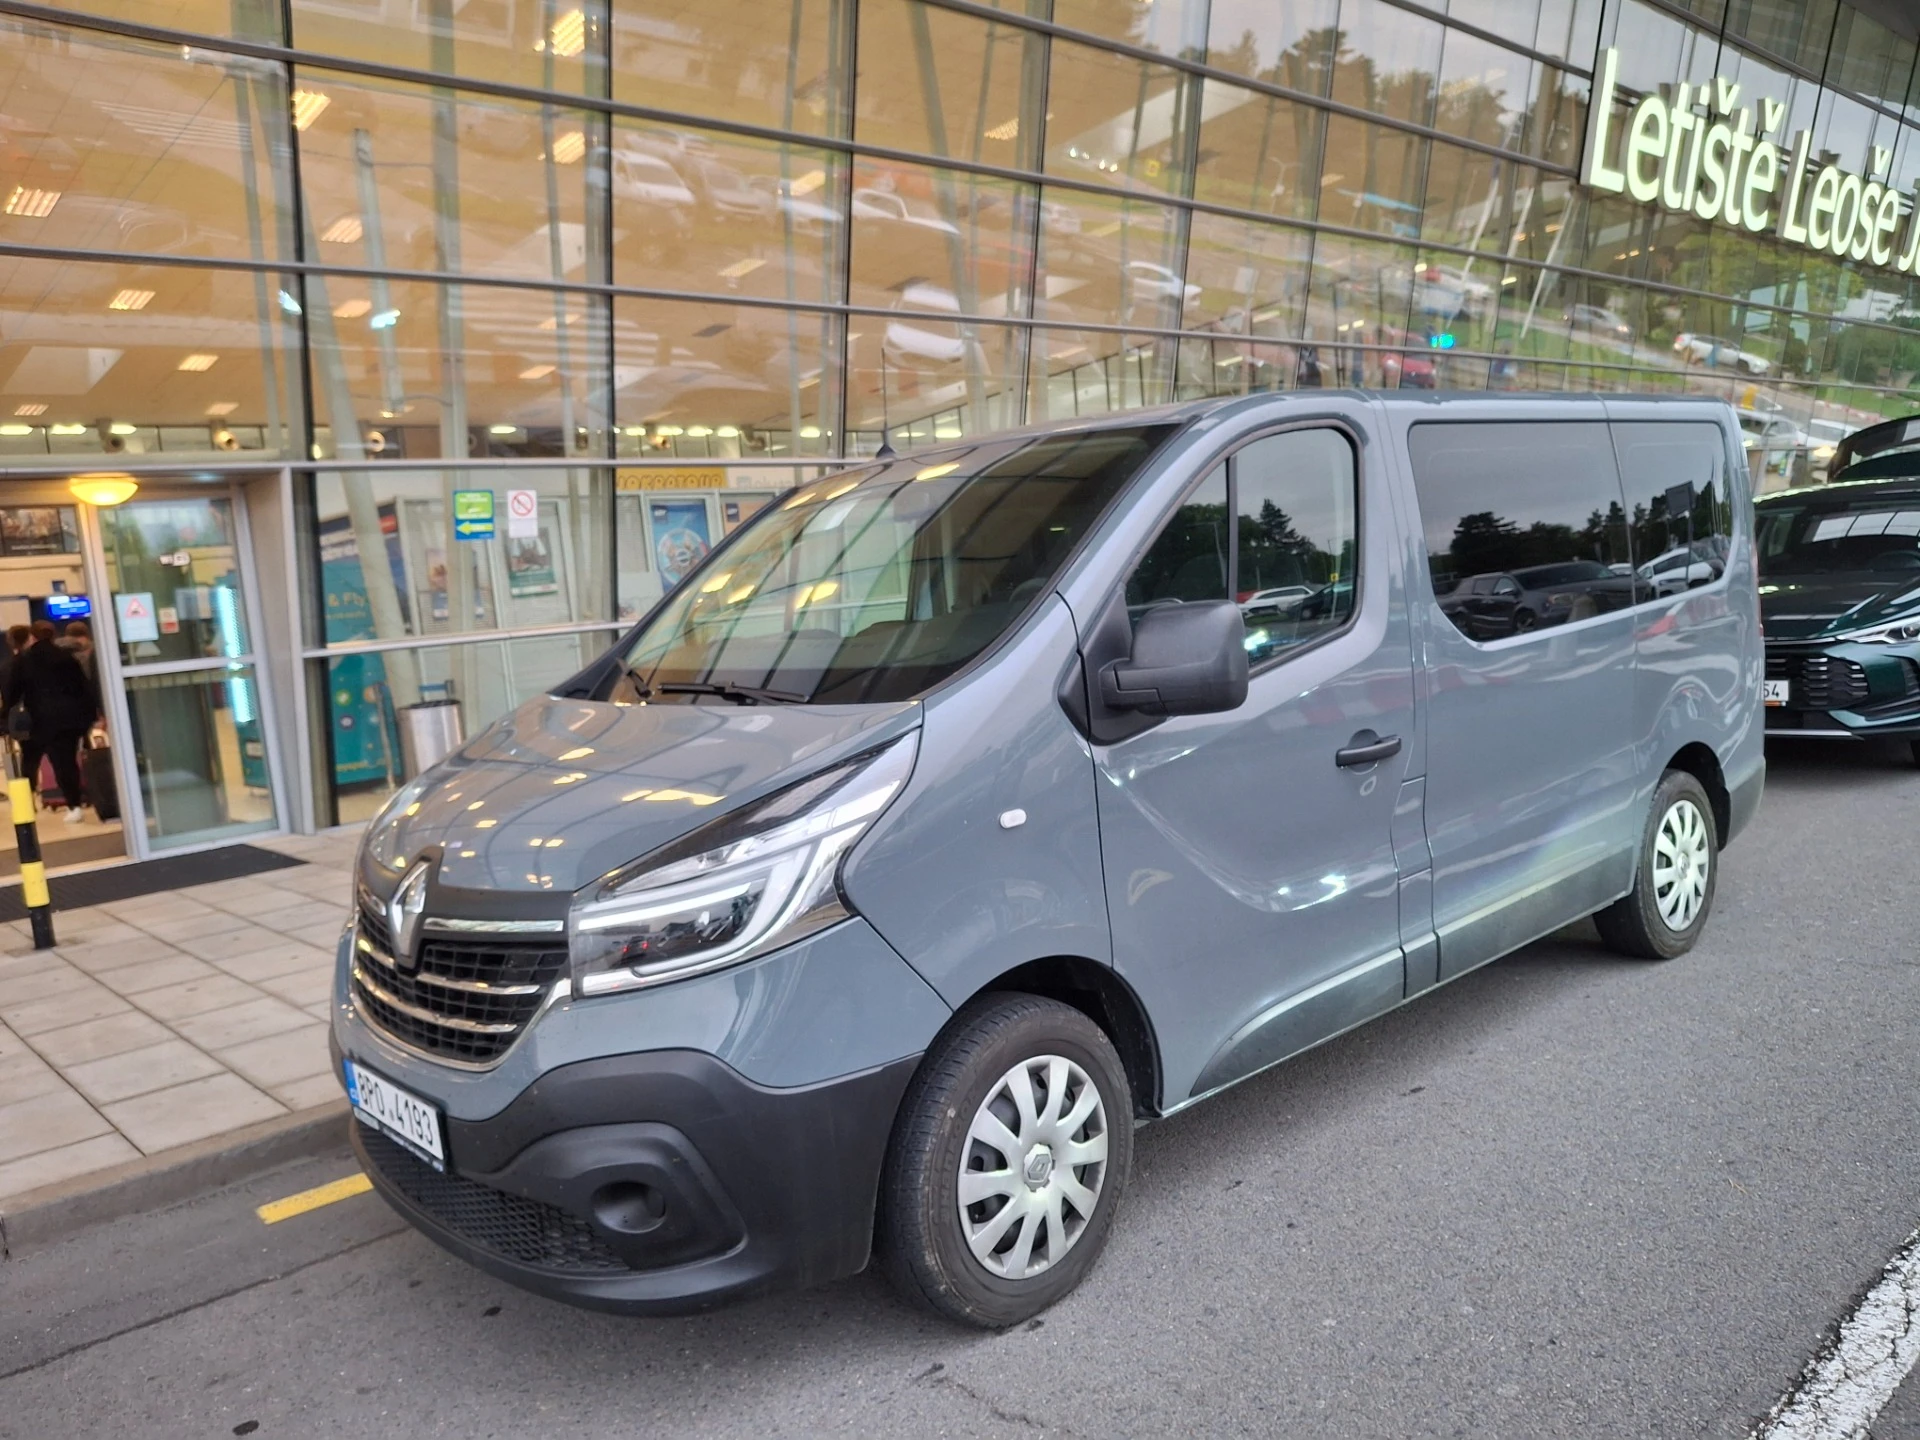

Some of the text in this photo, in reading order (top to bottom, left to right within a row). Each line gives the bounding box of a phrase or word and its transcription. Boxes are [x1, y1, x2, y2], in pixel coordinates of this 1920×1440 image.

[1590, 48, 1785, 232] Letiště
[1783, 130, 1899, 266] Leoše
[395, 1094, 433, 1146] 4193
